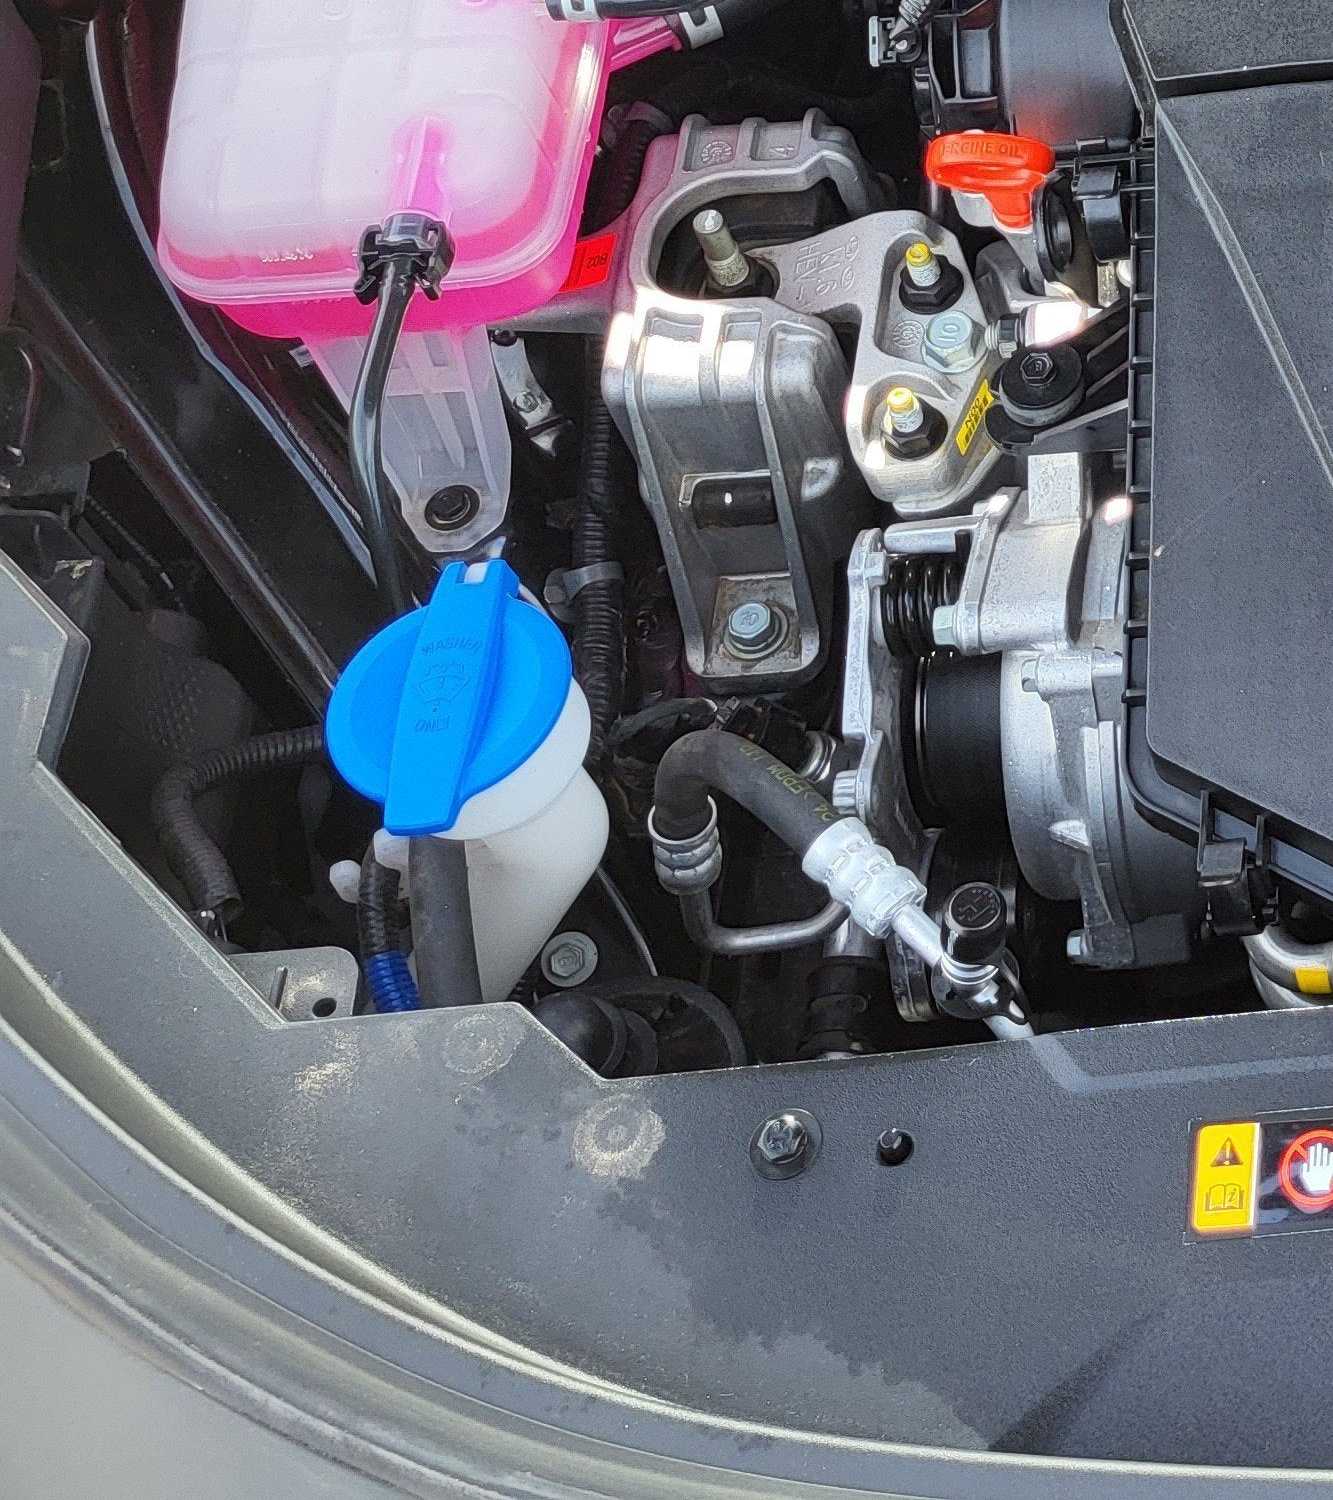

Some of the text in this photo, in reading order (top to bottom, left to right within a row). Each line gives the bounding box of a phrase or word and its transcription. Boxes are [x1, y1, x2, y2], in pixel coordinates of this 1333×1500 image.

[940, 139, 1026, 159] ENGINE OIL
[421, 636, 484, 656] WASHER
[415, 715, 451, 733] ONLY
